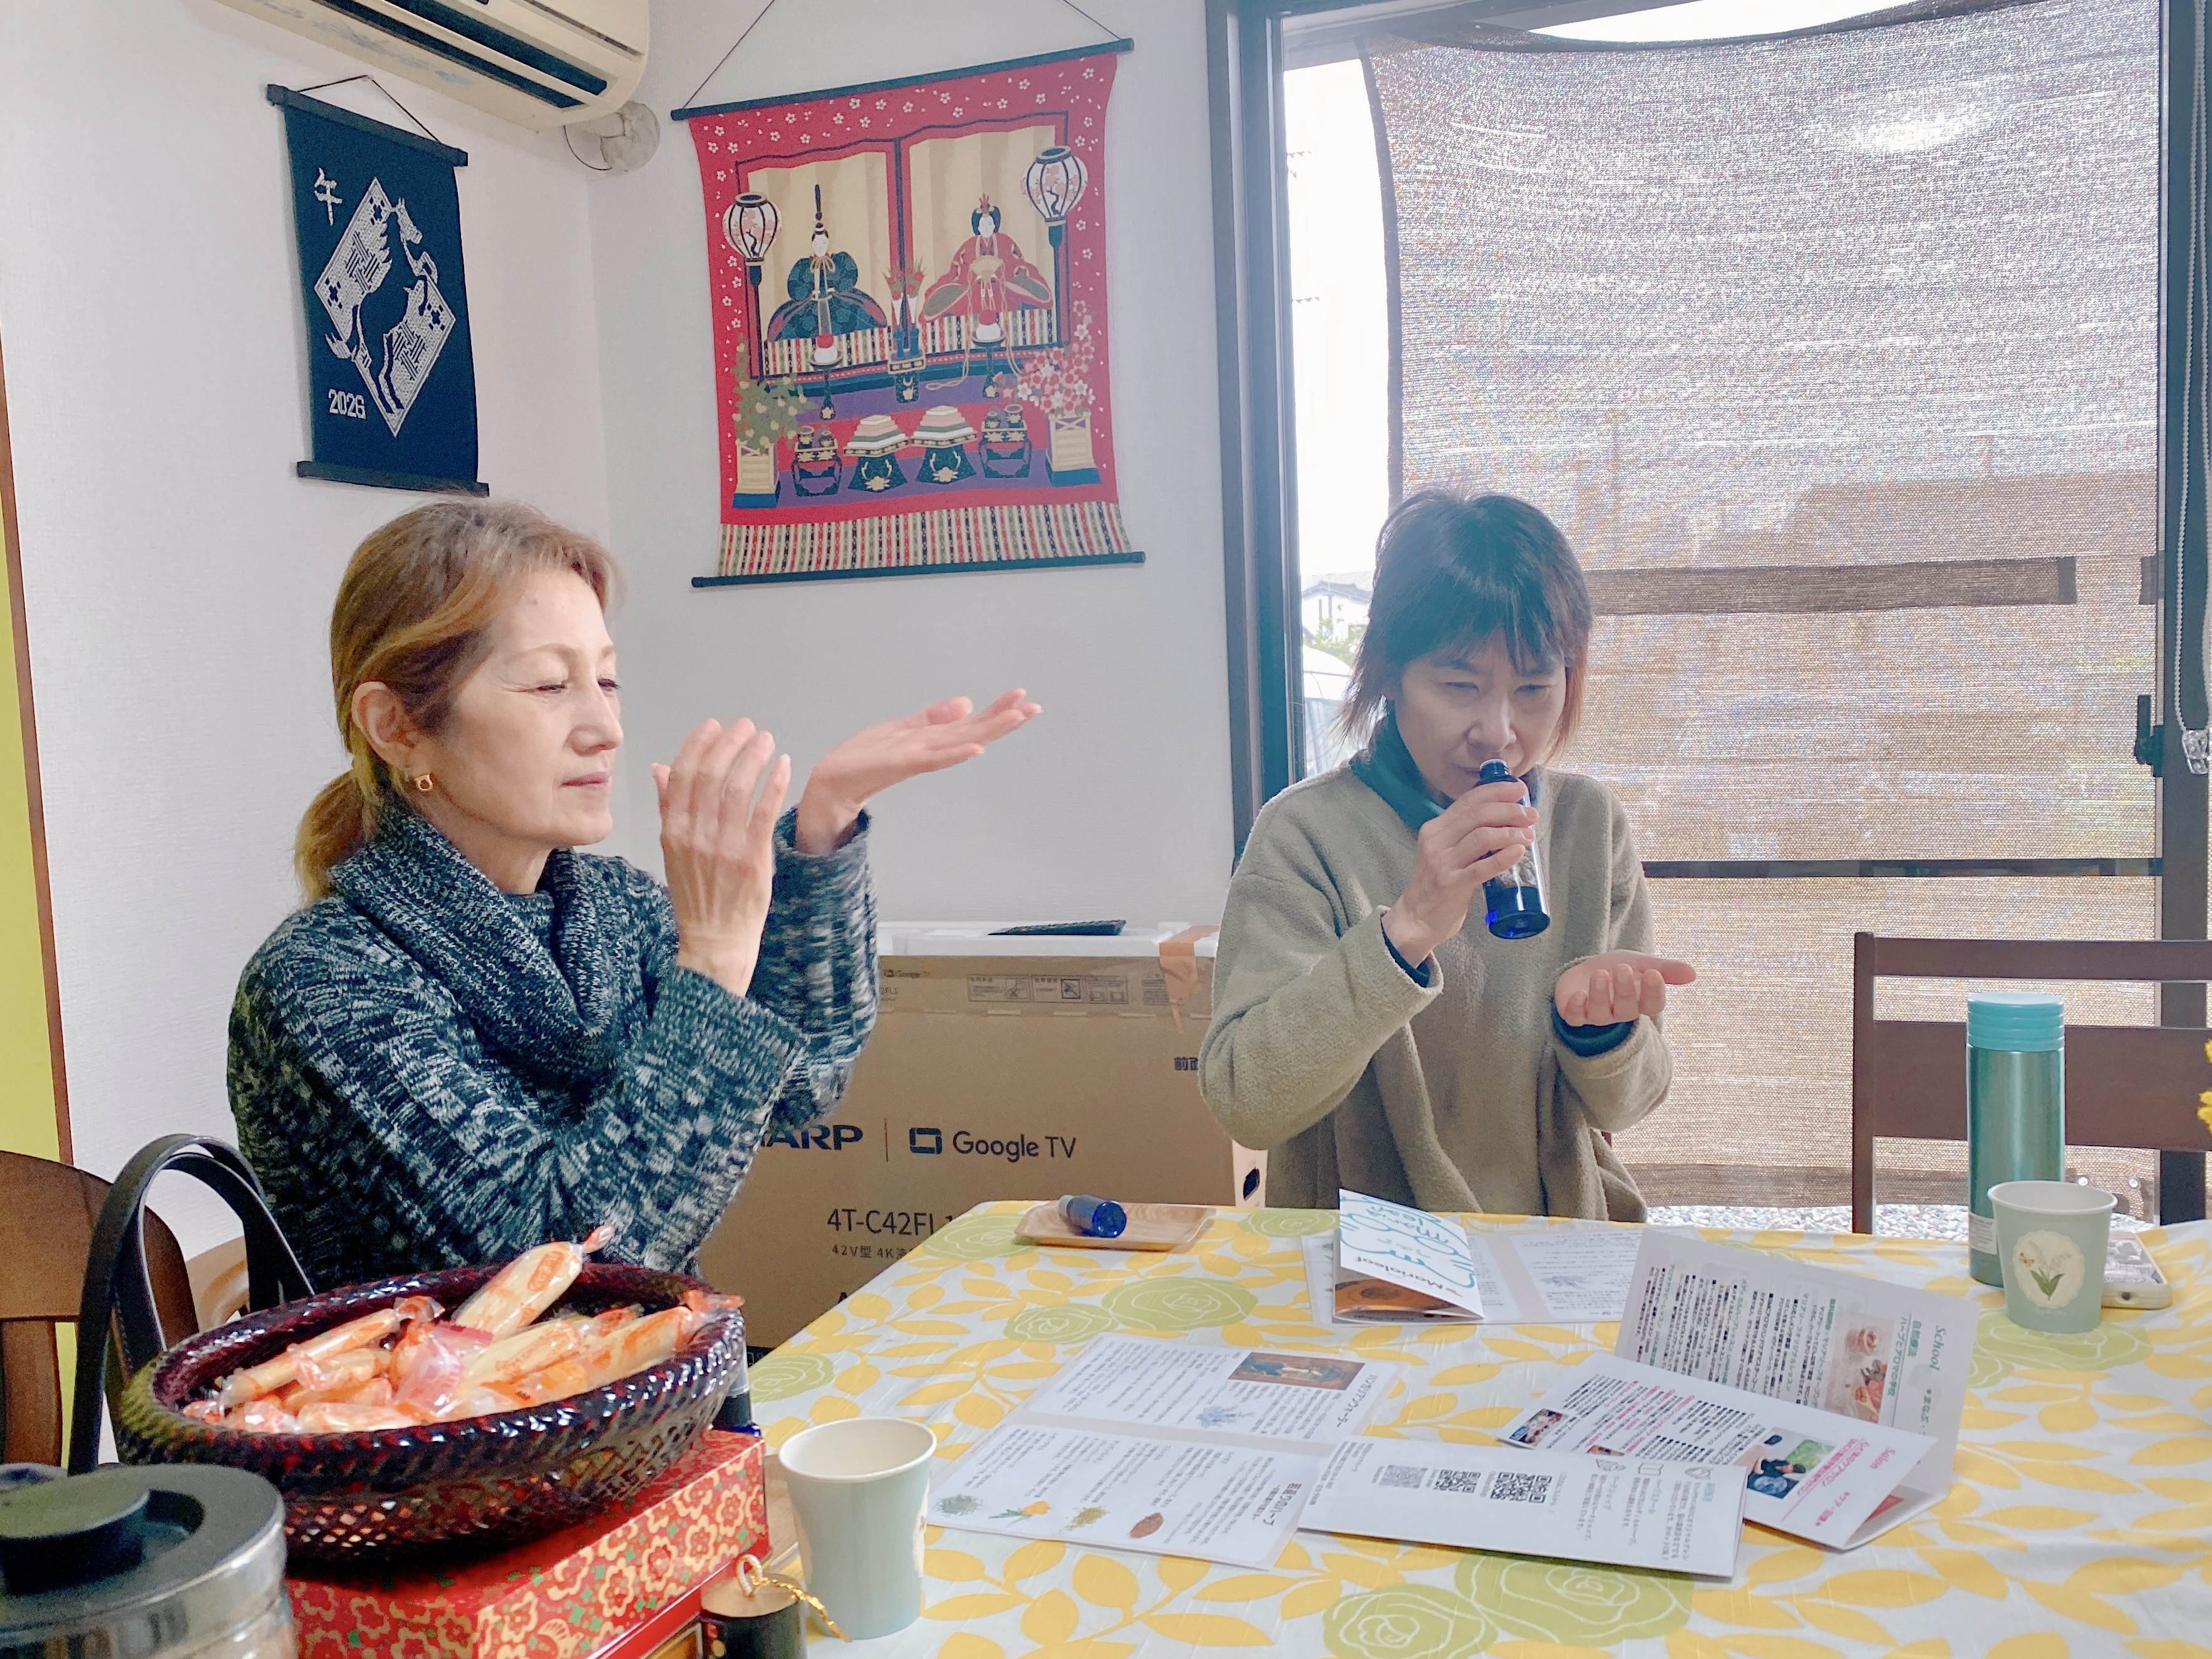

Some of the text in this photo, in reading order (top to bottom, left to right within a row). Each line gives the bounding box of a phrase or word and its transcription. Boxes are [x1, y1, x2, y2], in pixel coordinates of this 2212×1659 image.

[313, 167, 343, 225] 午
[329, 387, 366, 420] 2026
[760, 1124, 1077, 1162] ARP Google TV
[1887, 1316, 1908, 1396] ハーブとアロマの学校
[1930, 1325, 1946, 1370] School
[1869, 1447, 1896, 1470] Salon
